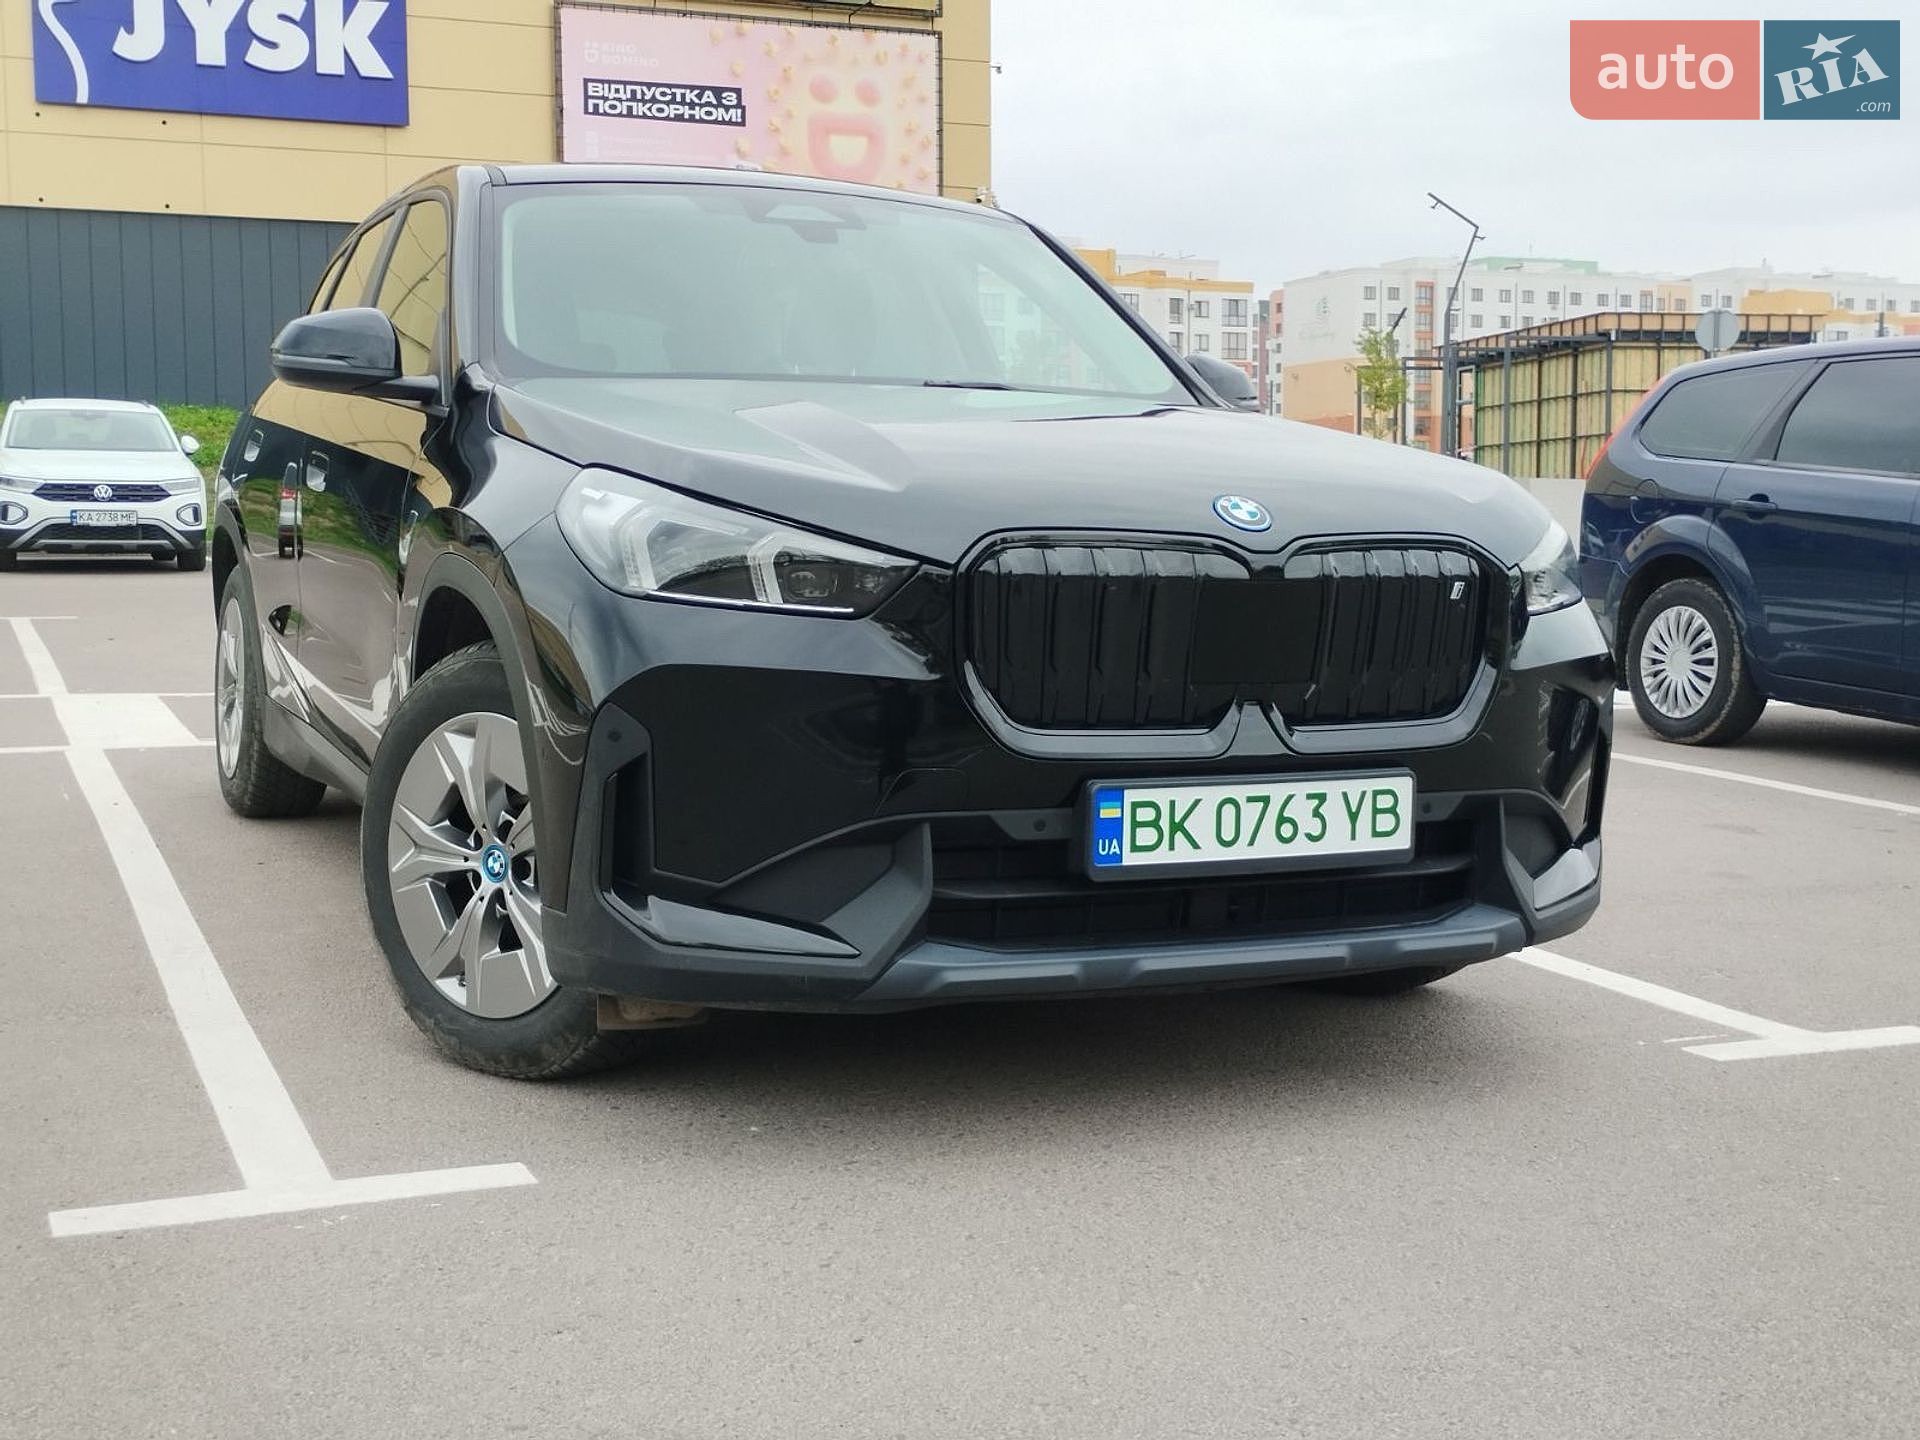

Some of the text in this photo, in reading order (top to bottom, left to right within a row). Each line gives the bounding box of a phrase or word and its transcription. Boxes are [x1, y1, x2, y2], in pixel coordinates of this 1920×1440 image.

[112, 0, 394, 80] JYSK
[587, 82, 717, 105] ВІДПУСТКА
[587, 98, 742, 122] ПОПКОРНОМ!
[79, 512, 93, 521] KA
[95, 512, 119, 521] 2738
[1130, 788, 1401, 853] BK 0763 YB
[1098, 838, 1121, 856] UA
